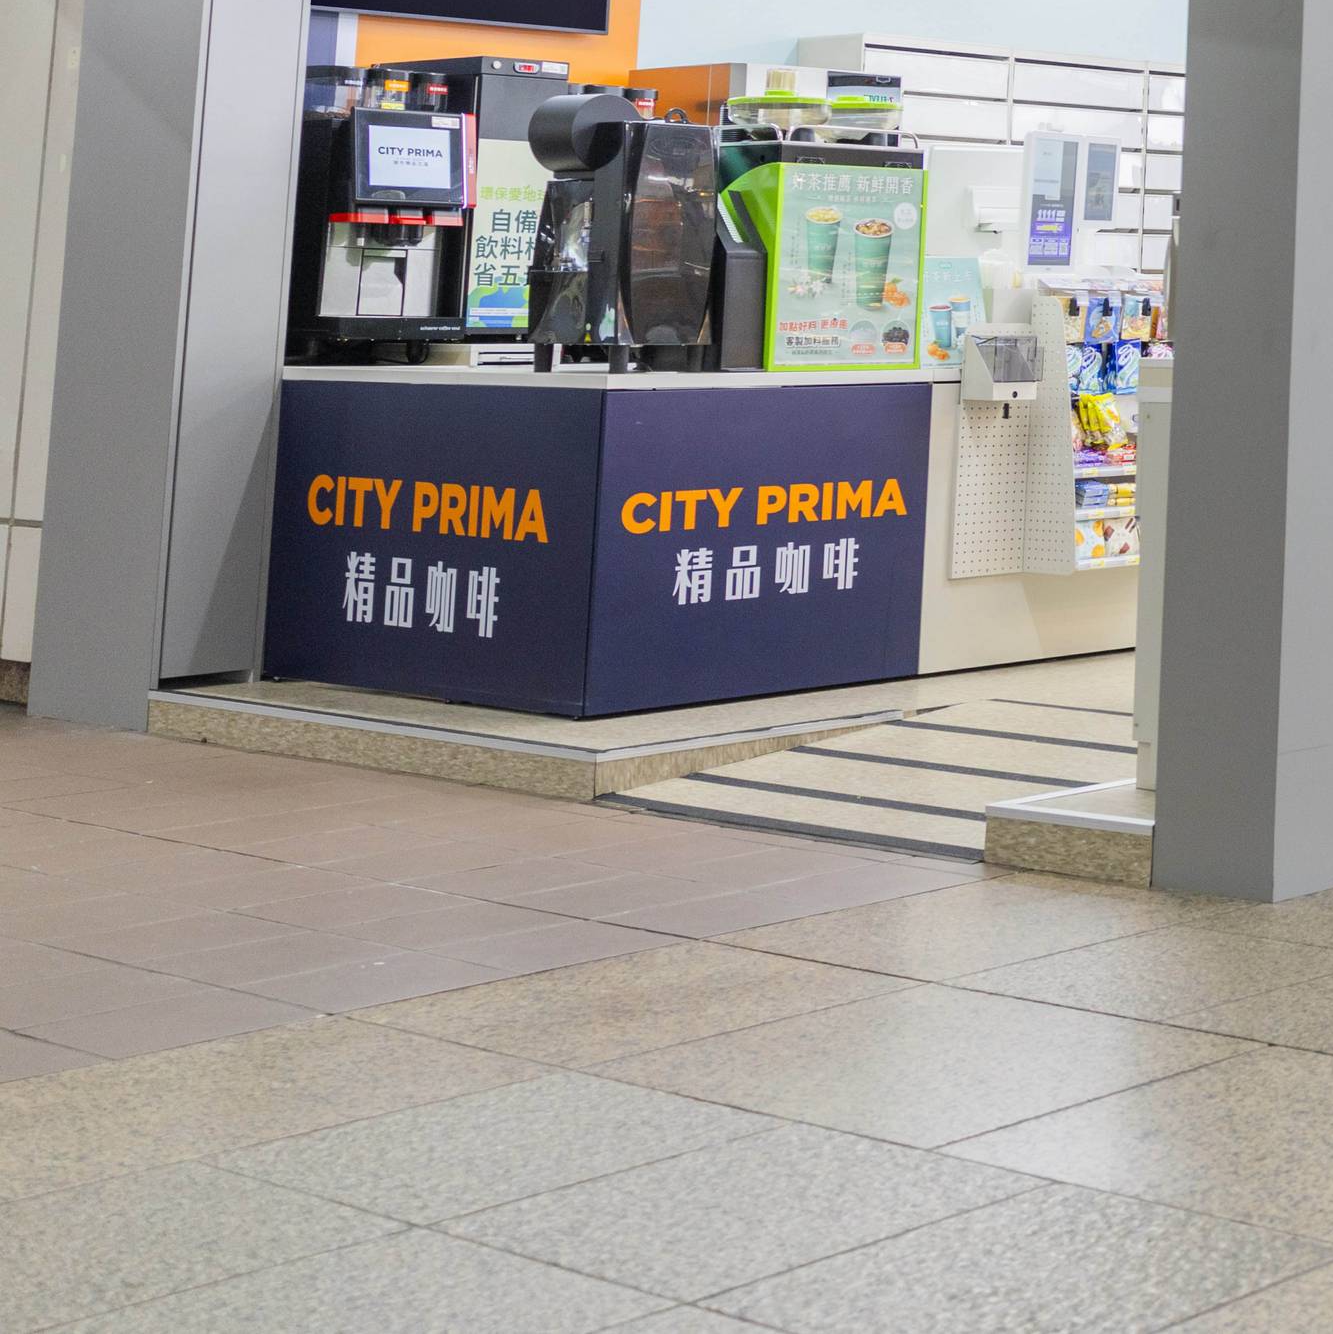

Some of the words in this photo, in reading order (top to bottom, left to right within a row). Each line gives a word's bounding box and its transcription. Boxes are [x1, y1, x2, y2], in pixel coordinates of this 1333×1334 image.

[377, 146, 404, 157] CITY
[407, 148, 443, 159] PRIMA
[307, 474, 405, 531] CITY
[412, 480, 549, 543] PRIMA
[620, 487, 742, 535] CITY
[756, 478, 908, 526] PRIMA
[342, 550, 502, 639] 精品咖啡
[672, 537, 861, 605] 精品咖啡
